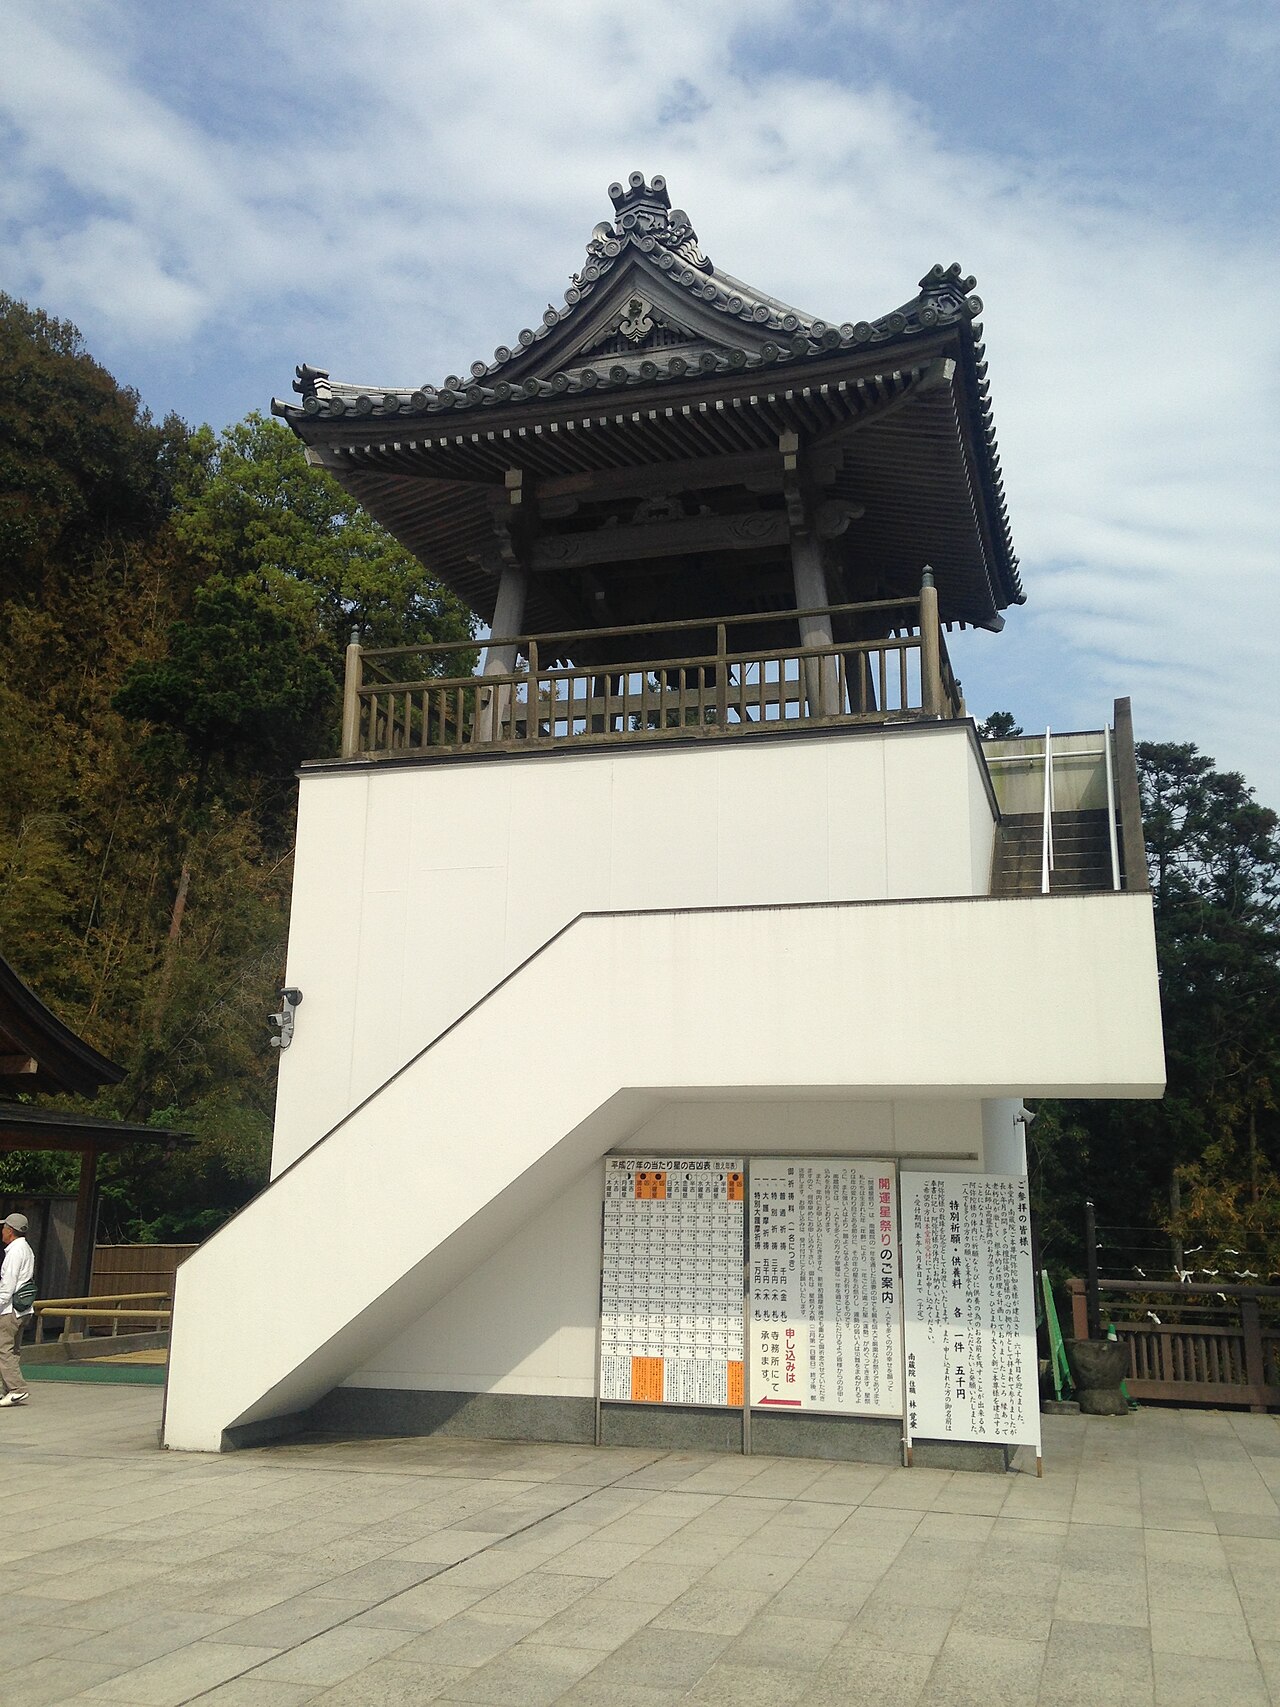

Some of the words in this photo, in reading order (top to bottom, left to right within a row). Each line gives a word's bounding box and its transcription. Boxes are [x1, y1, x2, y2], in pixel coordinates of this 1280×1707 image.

[611, 1160, 711, 1170] 平成27年の当たり星の吉凶表
[879, 1178, 894, 1303] 開運星祭りのご案内
[1018, 1180, 1029, 1256] ご参拝の皆様へ
[949, 1200, 962, 1289] 特別祈願・供養料
[954, 1307, 963, 1318] 各
[761, 1331, 770, 1381] 承ります。
[771, 1331, 780, 1392] 寺務所にて
[785, 1328, 796, 1383] 申し込みは
[954, 1334, 964, 1352] 一件
[955, 1366, 966, 1399] 五千円
